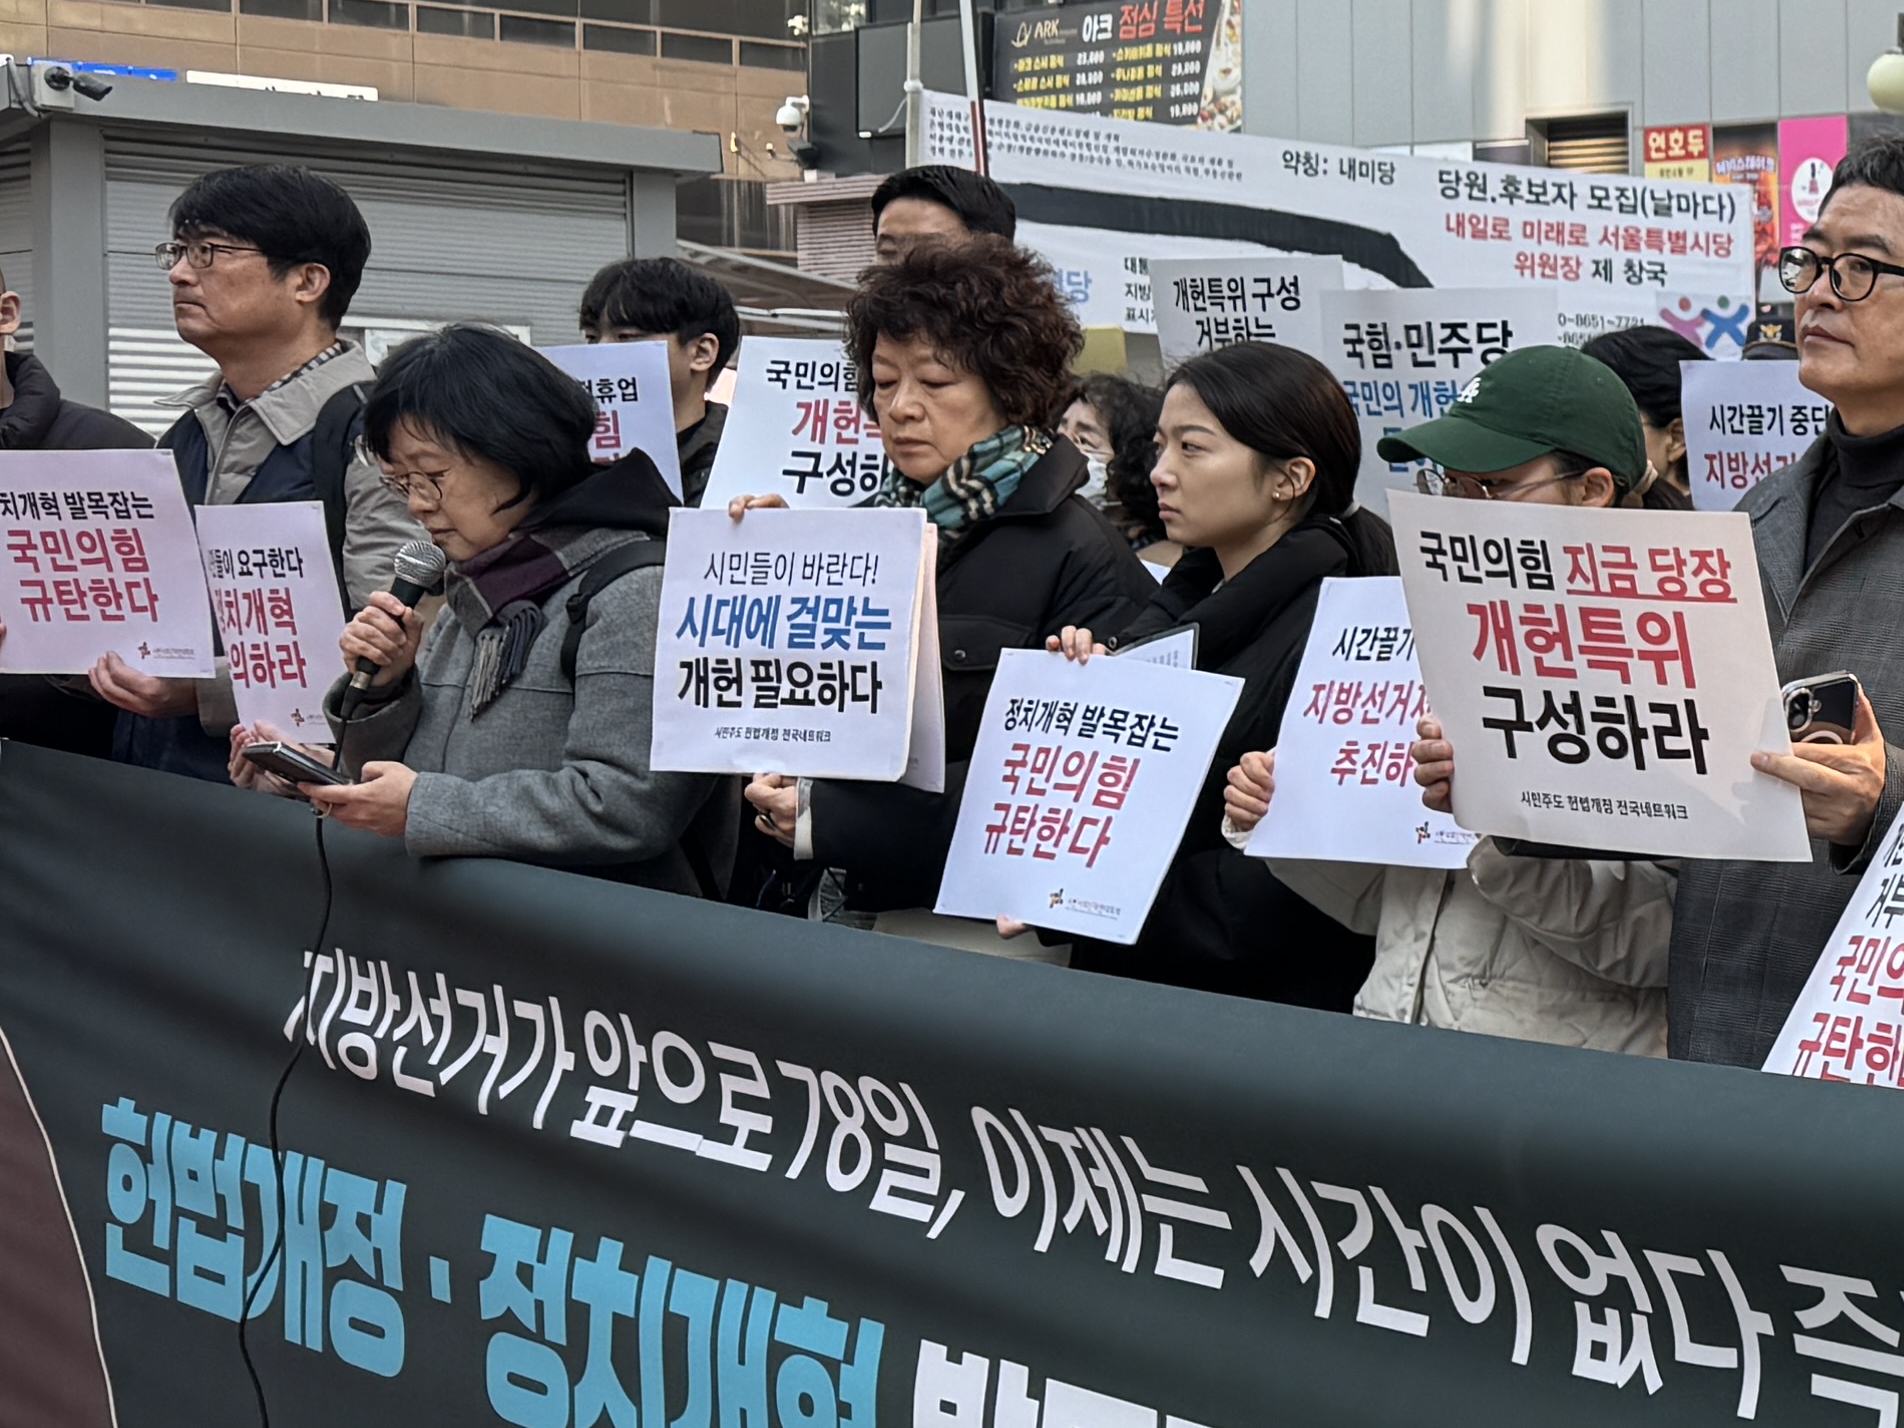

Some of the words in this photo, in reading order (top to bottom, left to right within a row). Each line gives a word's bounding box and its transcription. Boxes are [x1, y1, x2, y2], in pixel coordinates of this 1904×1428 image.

[1034, 19, 1060, 39] ARK
[1083, 14, 1112, 42] 아크
[1119, 1, 1158, 39] 점심
[1282, 150, 1327, 175] 약칭:
[1339, 158, 1396, 185] 내미당
[1587, 184, 1736, 224] 모집(날마다)
[1445, 213, 1512, 242] 내일로
[1522, 219, 1589, 248] 미래로
[1599, 224, 1735, 259] 서울특별시당
[1514, 251, 1583, 282] 위원장
[1591, 258, 1613, 284] 제
[1173, 276, 1247, 314] 개헌특위
[1252, 275, 1302, 313] 구성
[1709, 404, 1784, 436] 시간끌기
[63, 490, 155, 521] 발목잡는
[7, 527, 150, 573] 국민의힘
[237, 546, 304, 579] 요구한다
[704, 551, 796, 587] 시민들이
[801, 552, 880, 587] 바란다!
[1419, 530, 1556, 591] 국민의힘
[1562, 542, 1641, 598] 지금
[1647, 547, 1736, 602] 당장
[20, 577, 160, 623] 규탄한다
[676, 593, 782, 650] 시대에
[786, 595, 893, 651] 걸맞는
[1467, 599, 1697, 690] 개헌특위
[677, 656, 743, 709] 개헌
[750, 658, 883, 714] 필요하다
[1003, 697, 1079, 737] 정치개혁
[1077, 703, 1181, 754] 발목잡는
[1482, 685, 1710, 776] 구성하라
[1002, 742, 1141, 812] 국민의힘
[1520, 790, 1565, 810] 시민주도
[1567, 795, 1614, 816] 헌법개정
[984, 802, 1114, 870] 규탄한다
[283, 946, 576, 1130] 지방선거가
[570, 1006, 777, 1172] 앞으로
[782, 1060, 967, 1240] 78일,
[970, 1102, 1232, 1290] 이제는
[1248, 1163, 1534, 1366] 시간이
[1535, 1220, 1779, 1422] 없다
[100, 1094, 409, 1378] 헌법개정
